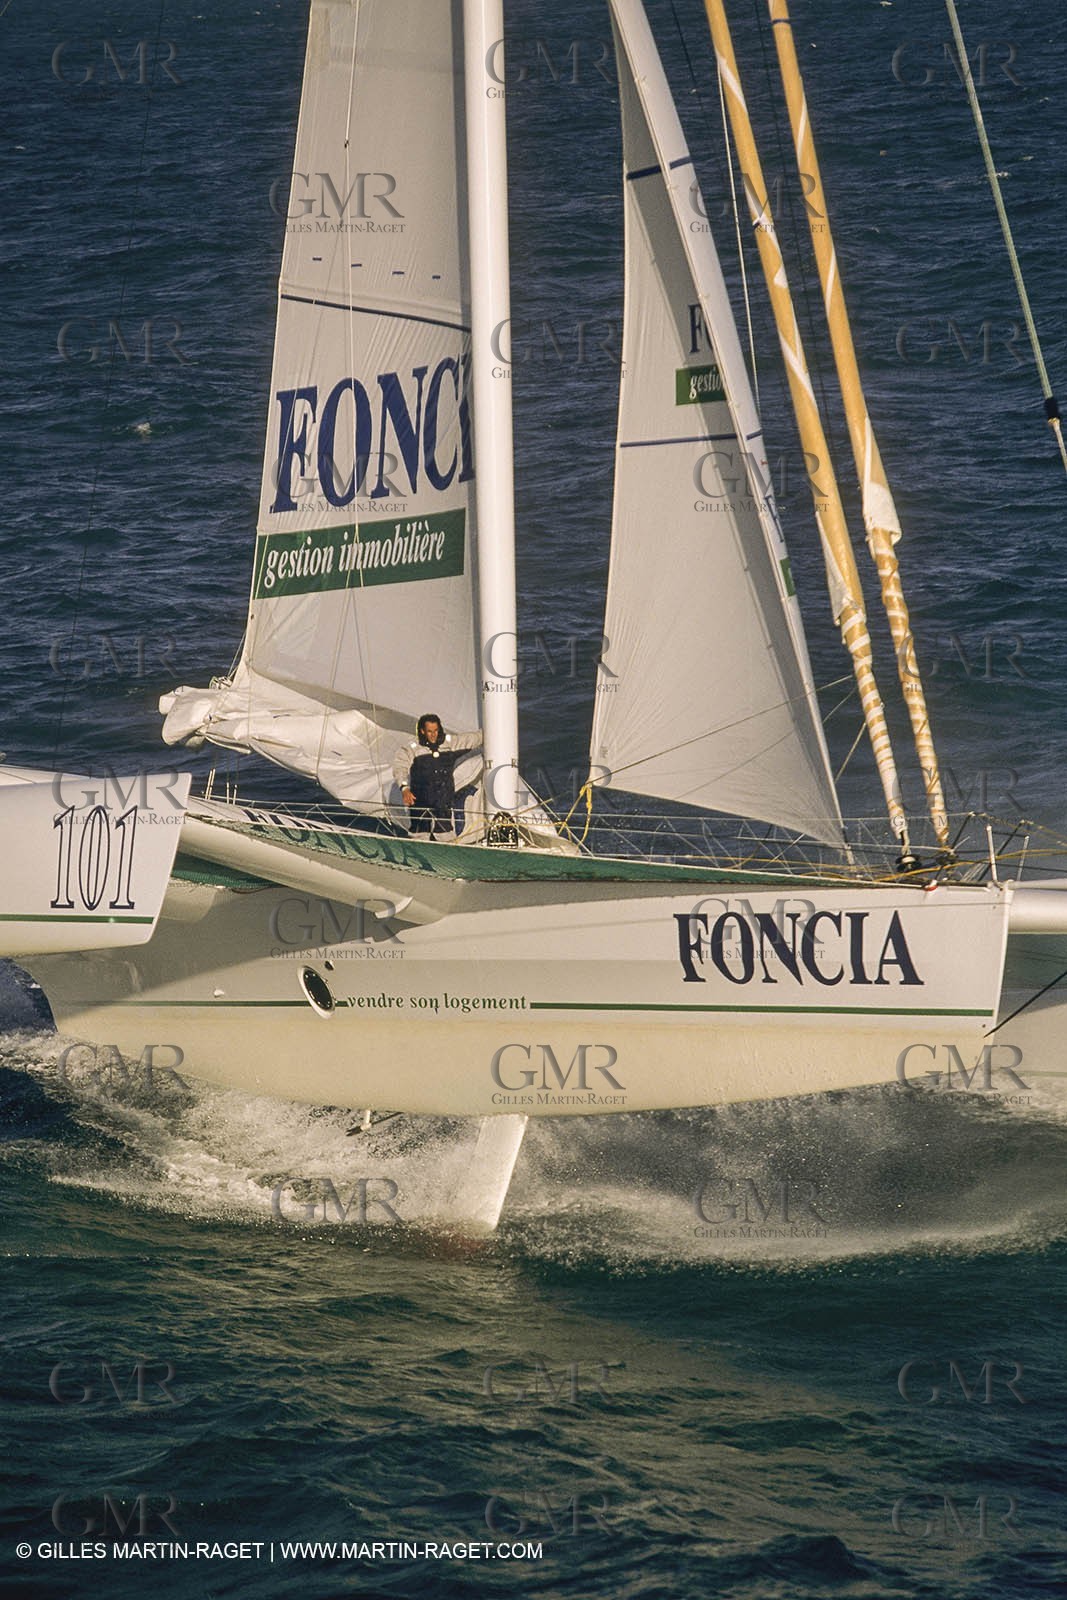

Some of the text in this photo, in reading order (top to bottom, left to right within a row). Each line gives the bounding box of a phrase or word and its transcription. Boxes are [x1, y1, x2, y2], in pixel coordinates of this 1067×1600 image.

[263, 519, 446, 589] gestion immobilière
[50, 804, 138, 911] 101
[673, 910, 925, 986] FONCIA
[347, 993, 526, 1013] vendre son logement
